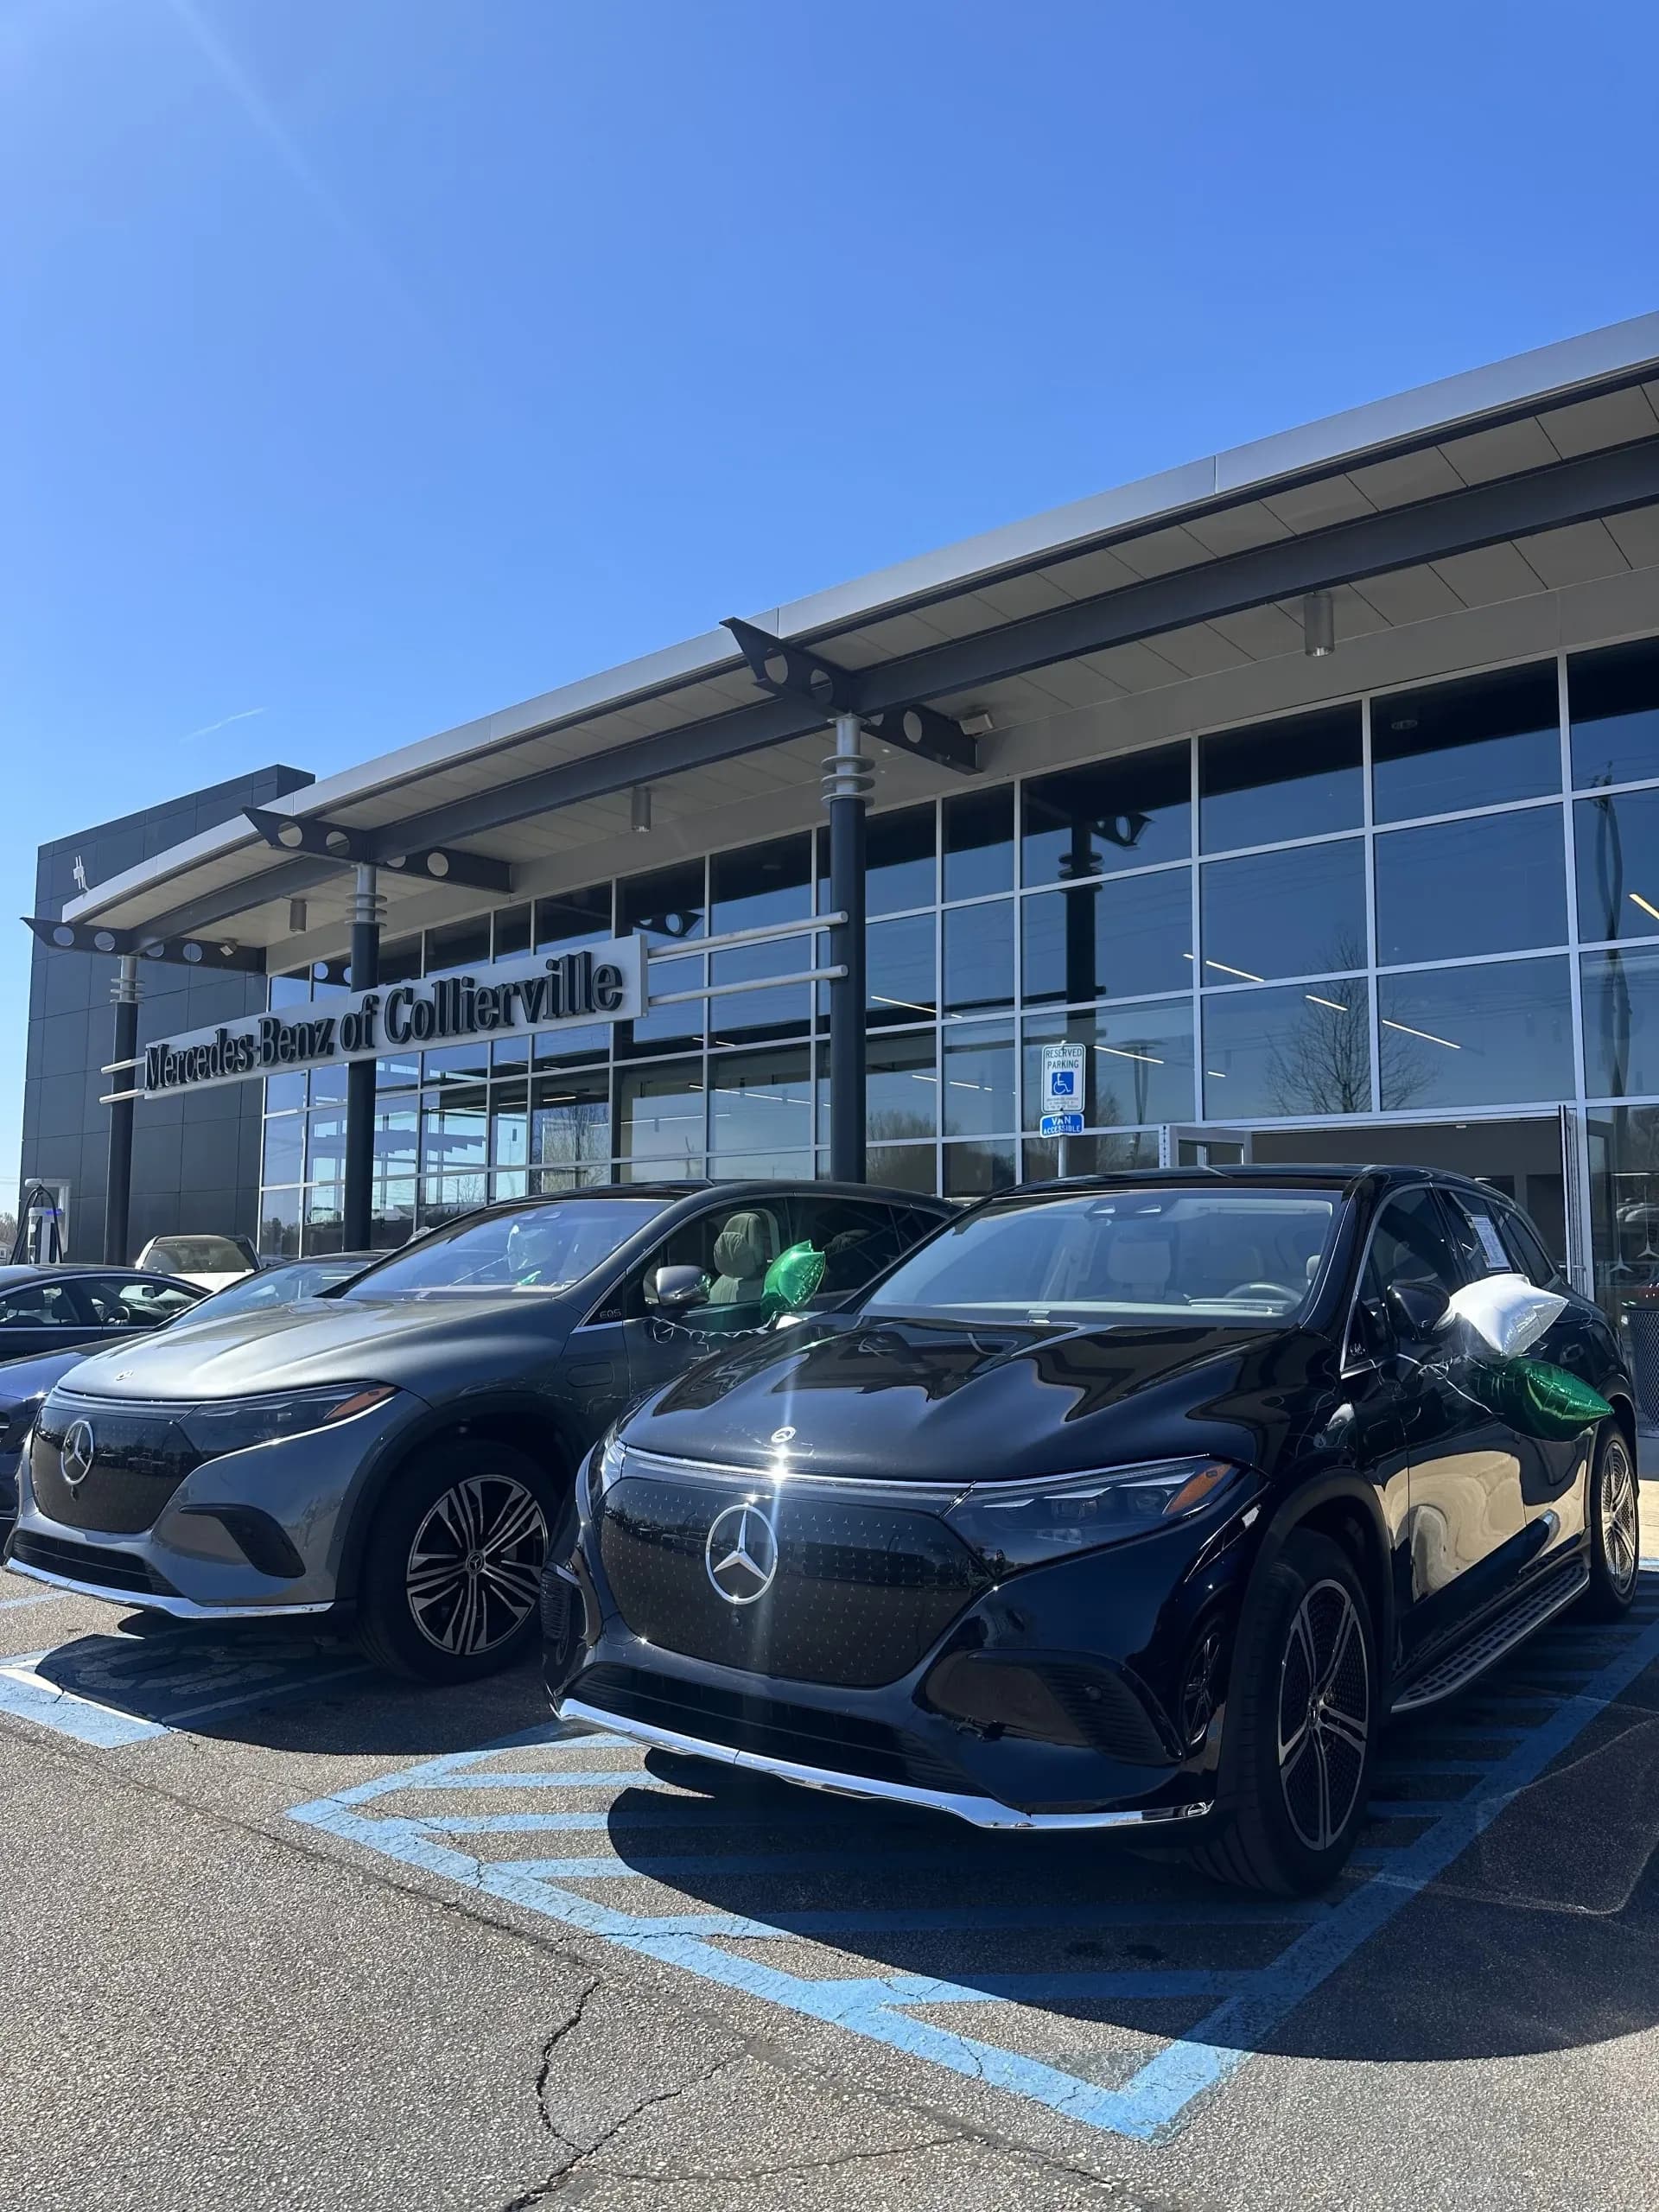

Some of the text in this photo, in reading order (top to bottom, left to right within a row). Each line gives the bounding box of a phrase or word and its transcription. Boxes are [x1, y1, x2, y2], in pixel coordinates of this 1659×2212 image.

[145, 950, 623, 1090] Mercedes-Benz of Collierville
[1046, 1047, 1082, 1058] RESERVED
[1047, 1059, 1079, 1070] PARKING
[1051, 1116, 1071, 1126] VAN
[1043, 1125, 1081, 1135] ACCESSIBLE
